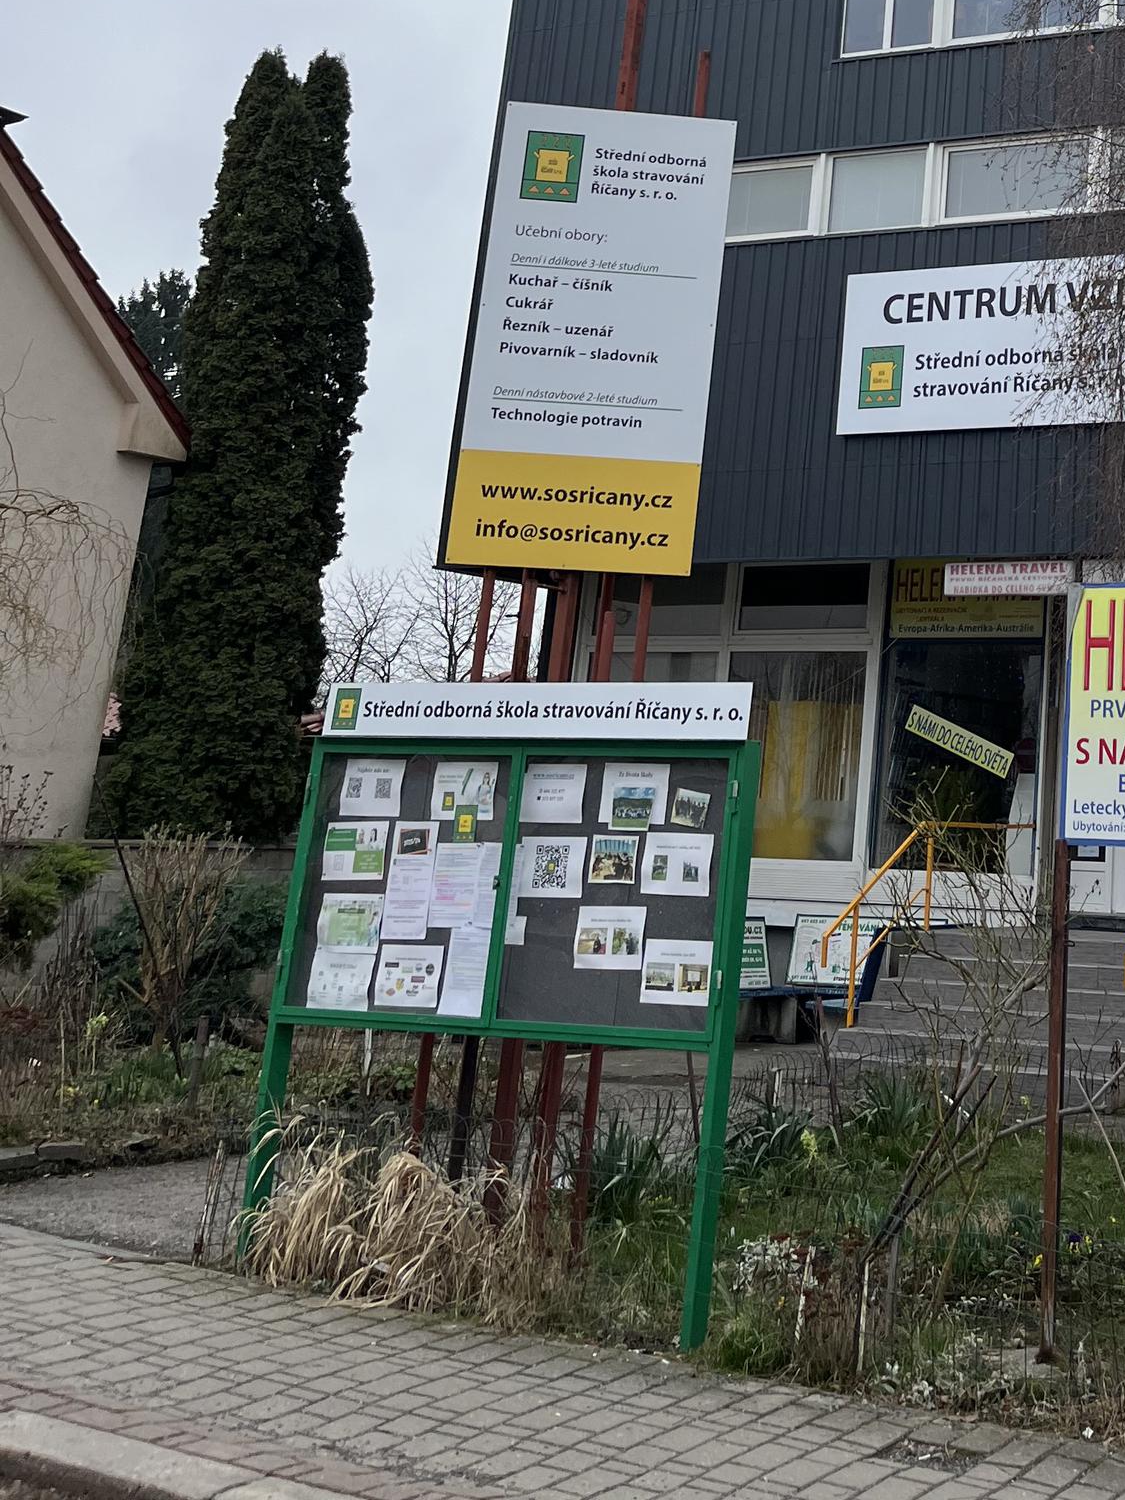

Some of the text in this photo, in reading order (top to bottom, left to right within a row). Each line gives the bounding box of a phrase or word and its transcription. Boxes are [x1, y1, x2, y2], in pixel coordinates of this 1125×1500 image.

[595, 147, 707, 168] Střední odborná
[592, 165, 705, 185] škola stravování
[590, 180, 637, 200] Říčany
[515, 224, 608, 245] Učební obory:
[511, 252, 543, 264] Denní
[547, 256, 588, 268] dálkové
[588, 258, 618, 270] 3-leté
[618, 262, 659, 273] studium
[508, 273, 559, 288] Kuchař
[572, 278, 613, 292] číšník
[505, 296, 554, 311] Cukrář
[882, 284, 1058, 325] CENTRUM
[502, 316, 550, 334] Řezník
[565, 325, 614, 338] uzenář
[499, 341, 576, 358] Pivovarník
[590, 347, 658, 364] sladovník
[915, 349, 981, 371] Střední
[984, 343, 1065, 369] odborná
[913, 375, 1011, 398] stravování
[1012, 368, 1075, 398] Říčany
[493, 385, 658, 406] Denní nástavbové 2-leté studium
[491, 406, 642, 429] Technologie potravin
[481, 484, 673, 511] www.sosricany.cz
[475, 519, 669, 550] info@sosricany.cz
[950, 562, 1067, 575] HELENA TRAVEL
[362, 698, 743, 725] Střední odborná škola stravování Říčany s. r. o.
[914, 714, 937, 740] NÁMI
[936, 725, 952, 745] DO
[950, 733, 983, 761] CELÉHO
[981, 749, 1009, 776] SVĚTA
[1075, 737, 1090, 765] S
[1072, 820, 1125, 834] Ubytování:
